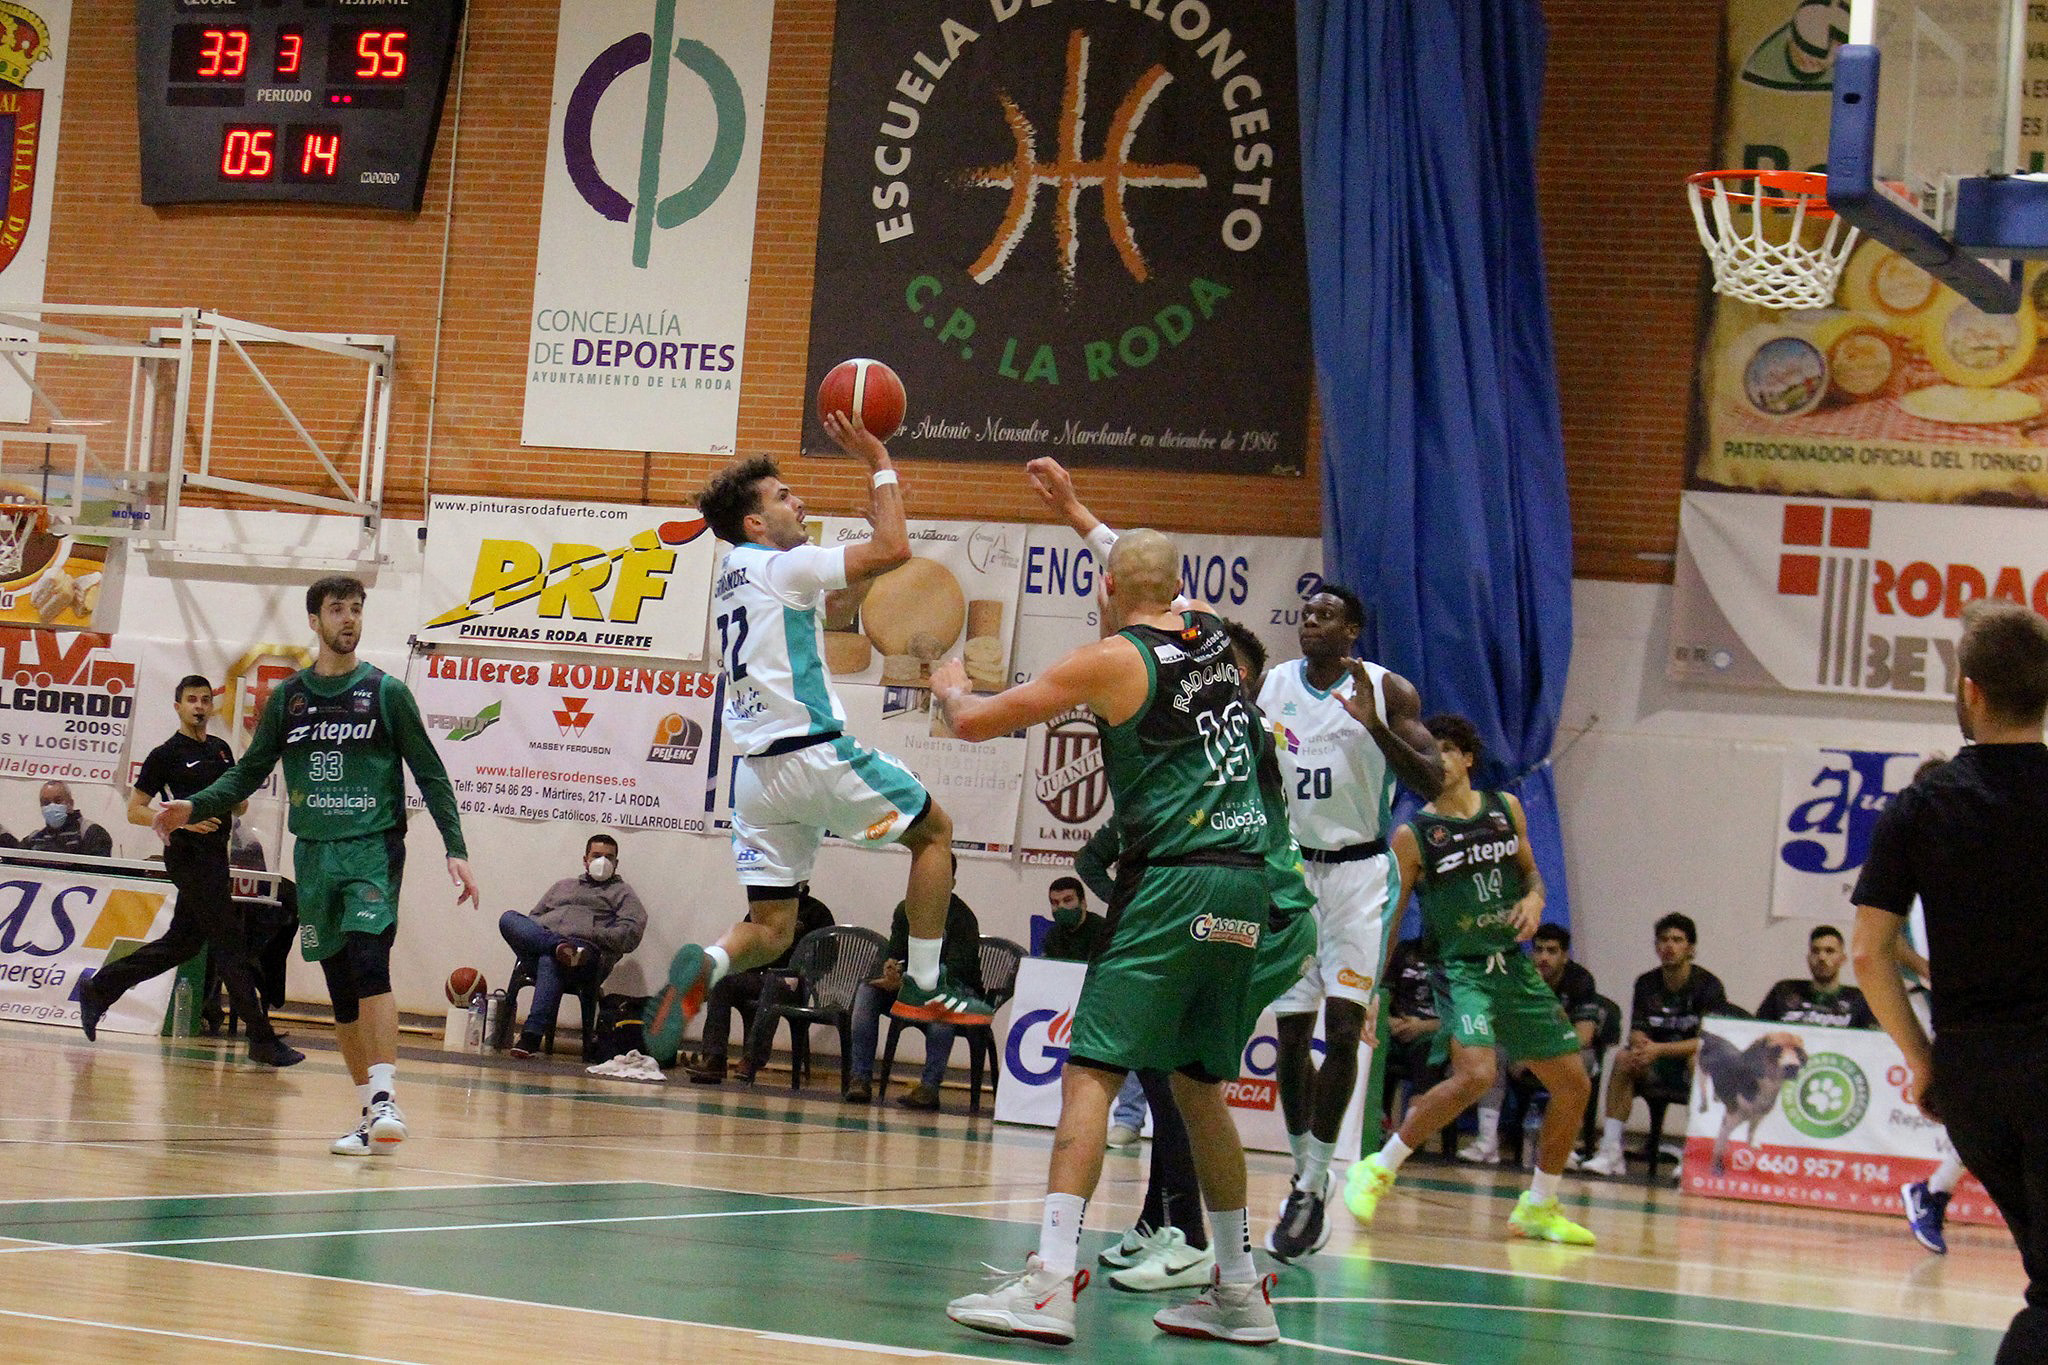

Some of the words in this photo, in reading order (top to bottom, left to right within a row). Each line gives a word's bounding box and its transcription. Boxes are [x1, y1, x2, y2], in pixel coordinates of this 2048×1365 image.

[198, 30, 249, 77] 33
[277, 34, 302, 74] 3
[356, 31, 408, 78] 55
[257, 89, 312, 103] PERIODO
[872, 17, 981, 244] ESCUELA
[13, 121, 37, 193] VILLA
[222, 130, 273, 176] 05
[302, 134, 338, 175] 14
[4, 215, 26, 250] DE
[537, 308, 682, 337] CONCEJALÍA
[905, 275, 977, 361] C.P.
[998, 337, 1060, 387] LA
[1083, 276, 1233, 383] RODA
[534, 342, 565, 365] DE
[571, 338, 736, 372] DEPORTES
[532, 371, 640, 388] AYUNTAMIENTO
[647, 376, 664, 388] DE
[671, 378, 688, 389] LA
[695, 379, 733, 391] RODA
[911, 415, 971, 441] Antonio
[975, 416, 1050, 445] Monsalve
[1053, 419, 1138, 448] Marchante
[1140, 434, 1155, 447] en
[1723, 441, 1855, 463] PATROCINADOR
[1859, 449, 1925, 468] OFICIAL
[1931, 452, 1963, 470] DEL
[1970, 453, 2042, 473] TORNEO
[434, 501, 628, 520] www.pinturasrodafuerte.com
[460, 624, 540, 641] PINTURAS
[546, 630, 588, 643] RODA
[595, 633, 653, 648] FUERTE
[426, 653, 540, 687] Talleres
[548, 663, 716, 699] RODENSES
[65, 719, 111, 736] 2009
[312, 719, 377, 746] itepal
[18, 734, 30, 746] Y
[35, 735, 123, 754] LOGÍSTIC
[529, 741, 565, 753] MASSEY
[566, 744, 612, 756] FERGUSON
[651, 747, 694, 762] PELLENC
[308, 751, 344, 782] 33
[475, 763, 637, 789] www.talleresrodenses.es
[454, 780, 475, 793] Telf:
[476, 782, 493, 795] 967
[495, 784, 508, 796] 54
[509, 785, 521, 797] 86
[521, 786, 533, 798] 29
[542, 786, 587, 803] Mártires,
[588, 791, 606, 804] 217
[615, 792, 629, 805] LA
[629, 794, 660, 808] RODA
[1296, 766, 1332, 800] 20
[306, 794, 377, 813] Globalcaja
[461, 801, 472, 813] 46
[474, 802, 485, 813] 02
[492, 804, 517, 818] Avda.
[520, 806, 549, 821] Reyes
[552, 808, 597, 825] Católicos,
[601, 813, 613, 825] 26
[619, 814, 704, 832] VILLARROBLEDO
[1040, 827, 1057, 839] LA
[1472, 868, 1503, 903] 14
[1461, 1014, 1489, 1036] 14
[1756, 1153, 1799, 1176] 660
[1803, 1158, 1845, 1180] 957
[1852, 1162, 1890, 1184] 194
